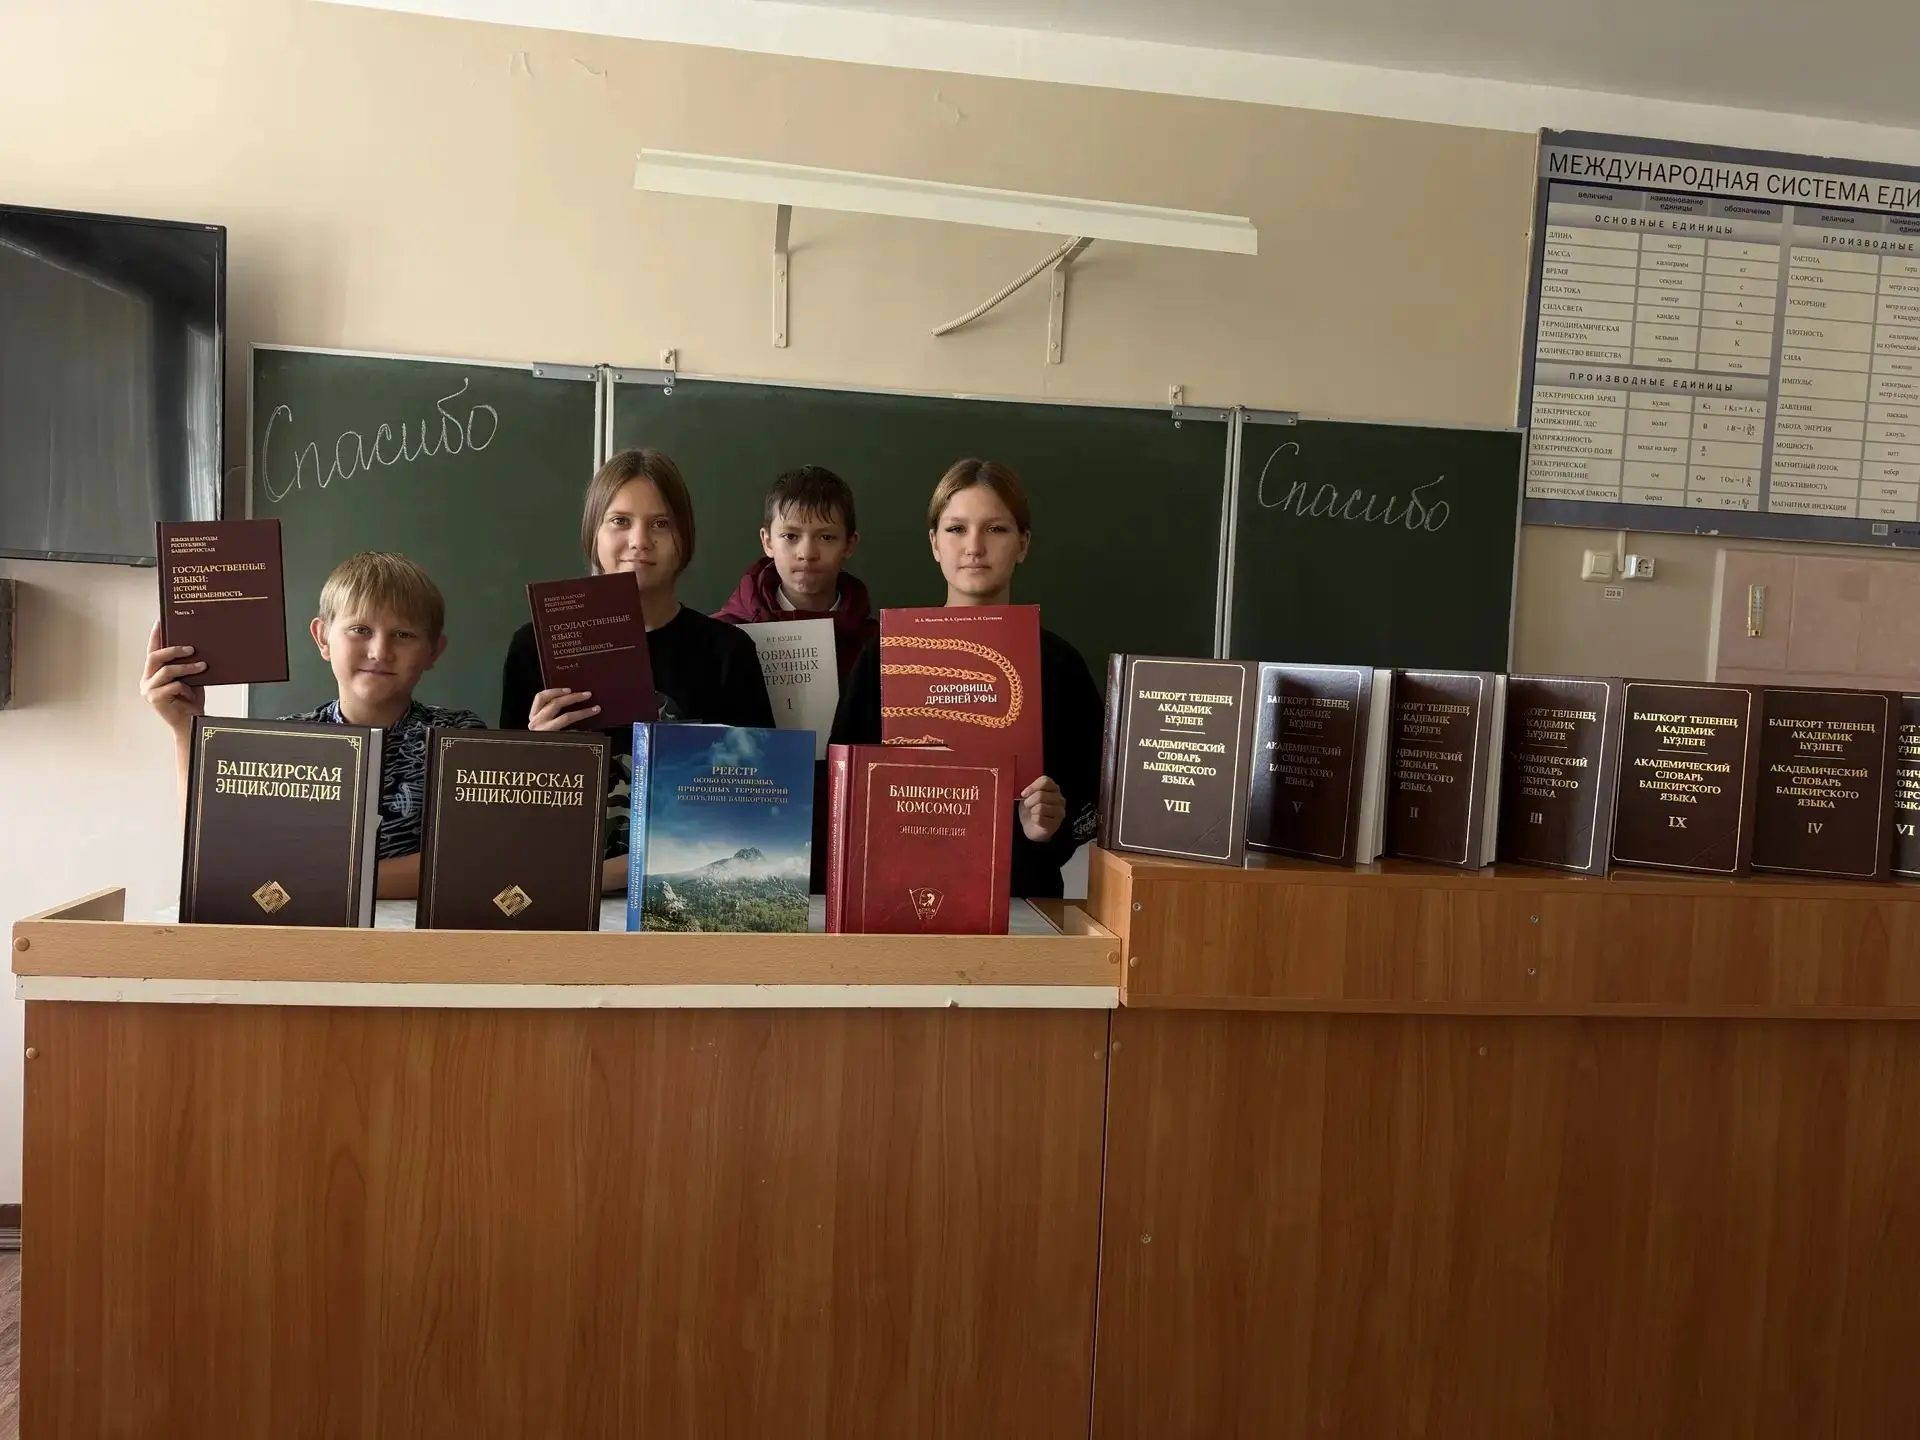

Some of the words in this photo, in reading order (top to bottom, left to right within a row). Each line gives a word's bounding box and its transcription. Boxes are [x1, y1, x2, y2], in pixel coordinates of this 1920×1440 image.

[1549, 152, 1759, 192] МЕЖДУНАРОДНАЯ
[1767, 174, 1870, 203] СИСТЕМА
[1877, 185, 1920, 210] ЕДИ
[1578, 191, 1613, 201] величина
[1650, 195, 1704, 206] наименование
[1660, 202, 1692, 213] единицы
[1724, 205, 1771, 216] обозначение
[1595, 214, 1665, 228] ОСНОВНЫЕ
[1672, 221, 1733, 235] ЕДИНИЦЫ
[1821, 214, 1855, 224] величина
[1890, 217, 1920, 226] наимено
[1549, 231, 1572, 240] ДЛИНА
[1822, 235, 1914, 251] ПРОИЗВОДНЫЕ
[1547, 249, 1571, 257] МАССА
[1792, 255, 1820, 264] ЧАСТОТА
[1545, 267, 1568, 275] ВРЕМЯ
[1790, 274, 1824, 283] СКОРОСТЬ
[1544, 285, 1562, 293] СИЛА
[1564, 286, 1581, 294] ТОКА
[1543, 303, 1561, 311] СИЛА
[1562, 304, 1583, 312] СВЕТА
[1789, 298, 1827, 308] УСКОРЕНИЕ
[1542, 320, 1620, 332] ТЕРМОДИНАМИЧЕСКАЯ
[1541, 330, 1588, 340] ТЕМПЕРАТУРА
[1786, 329, 1824, 338] ПЛОТНОСТЬ
[1539, 347, 1585, 356] КОЛИЧЕСТВО
[1585, 350, 1622, 359] ВЕЩЕСТВА
[1783, 353, 1802, 361] СИЛА
[1569, 372, 1665, 387] ПРОИЗВОДНЫЕ
[1673, 380, 1733, 392] ЕДИНИЦЫ
[1781, 378, 1813, 386] ИМПУЛЬС
[1536, 391, 1595, 401] ЭЛЕКТРИЧЕСКИЙ
[1597, 395, 1617, 403] ЗАРЯД
[1535, 407, 1592, 417] ЭЛЕКТРИЧЕСКОЕ
[1779, 403, 1812, 412] ДАВЛЕНИЕ
[1804, 424, 1832, 433] ЭНЕРГИЯ
[263, 377, 498, 503] Спасибо
[1533, 433, 1592, 443] НАПРЯЖЕННОСТЬ
[1532, 444, 1593, 454] ЭЛЕКТРИЧЕСКОГО
[1594, 447, 1613, 455] ПОЛЯ
[1776, 442, 1813, 451] МОЩНОСТЬ
[1531, 459, 1588, 469] ЭЛЕКТРИЧЕСКОЕ
[1774, 460, 1815, 470] МАГНИТНЫЙ
[1817, 463, 1839, 472] ПОТОК
[1530, 470, 1589, 479] СОПРОТИВЛЕНИЕ
[1258, 441, 1450, 531] Спасибо
[1773, 480, 1828, 490] ИНДУКТИВНОСТЬ
[1529, 486, 1586, 496] ЭЛЕКТРИЧЕСКАЯ
[1586, 490, 1618, 498] ЕМКОСТЬ
[1771, 500, 1811, 509] МАГНИТНАЯ
[1812, 502, 1847, 511] ИНДУКЦИЯ
[172, 562, 266, 574] ГОСУДАРСТВЕННЫЕ
[173, 575, 209, 584] ЯЗЫКИ:
[180, 590, 243, 600] СОВРЕМЕННОСТЬ
[549, 614, 631, 632] ГОСУДАРСТВЕННЫЕ
[551, 631, 582, 641] ЯЗЫКИ:
[552, 640, 582, 649] ИСТОРИЯ
[560, 642, 614, 656] СОВРЕМЕННОСТЬ
[757, 647, 819, 661] ОБРАНИЕ
[764, 660, 820, 674] АУЧНЫХ
[764, 673, 811, 686] ТРУДОВ
[929, 683, 994, 694] СОКРОВИЩА
[787, 697, 792, 709] 1
[925, 692, 971, 705] ДРЕВНЕЙ
[973, 693, 998, 704] УФЫ
[1189, 693, 1233, 707] ТЕЛЕНЕҢ
[1158, 703, 1212, 715] АКАДЕМИК
[1283, 708, 1331, 719] АКАДЕМИК
[1402, 713, 1451, 725] КАДЕМИК
[1551, 709, 1597, 722] ТЕЛЕНЕҢ
[1526, 719, 1575, 730] КАДЕМИК
[1689, 715, 1739, 728] ТЕЛЕНЕҢ
[1826, 721, 1876, 733] ТЕЛЕНЕҢ
[1655, 725, 1716, 736] АКАДЕМИК
[1791, 731, 1853, 742] АКАДЕМИК
[1139, 738, 1226, 753] АКАДЕМИЧЕСКИЙ
[1266, 741, 1342, 756] АКАДЕМИЧЕСКИЙ
[1157, 751, 1201, 763] СЛОВАРЬ
[1398, 748, 1463, 762] ДЕМИЧЕСКИЙ
[712, 765, 758, 776] РЕЕСТР
[1143, 762, 1217, 776] БАШКИРСКОГО
[1524, 766, 1563, 776] ЛОВАРЬ
[1634, 758, 1731, 773] АКАДЕМИЧЕСКИЙ
[1770, 764, 1868, 778] АКАДЕМИЧЕСКИЙ
[216, 760, 342, 783] БАШКИРСКАЯ
[1655, 770, 1704, 782] СЛОВАРЬ
[456, 769, 584, 789] БАШКИРСКАЯ
[693, 776, 720, 784] ОСОБО
[720, 777, 774, 786] ОХРАНЯЕМЫХ
[1161, 775, 1196, 786] ЯЗЫКА
[1792, 776, 1842, 787] СЛОВАРЬ
[215, 778, 341, 802] ЭНЦИКЛОПЕДИЯ
[677, 785, 731, 793] ПРИРОДНЫХ
[735, 786, 789, 795] ТЕРРИТОРИЙ
[889, 784, 980, 801] БАШКИРСКИЙ
[1400, 782, 1433, 793] ЯЗЫКА
[1522, 787, 1556, 798] ЯЗЫКА
[1639, 780, 1721, 794] БАШКИРСКОГО
[1776, 786, 1860, 799] БАШКИРСКОГО
[455, 787, 584, 807] ЭНЦИКЛОПЕДИЯ
[677, 794, 727, 802] РЕСПУБЛИКИ
[728, 795, 789, 804] БАШКОРТОСТАН
[1660, 793, 1698, 804] ЯЗЫКА
[896, 800, 972, 816] КОМСОМОЛ
[1164, 799, 1191, 813] VIII
[1292, 801, 1304, 813] V
[1797, 798, 1836, 809] ЯЗЫКА
[1894, 800, 1920, 811] ЗЫК
[1409, 807, 1419, 818] II
[1530, 812, 1543, 824] III
[1668, 816, 1688, 828] IX
[899, 825, 967, 837] ЭНЦИКЛОПЕДИЯ
[1808, 822, 1823, 834] IV
[1896, 823, 1916, 836] VI
